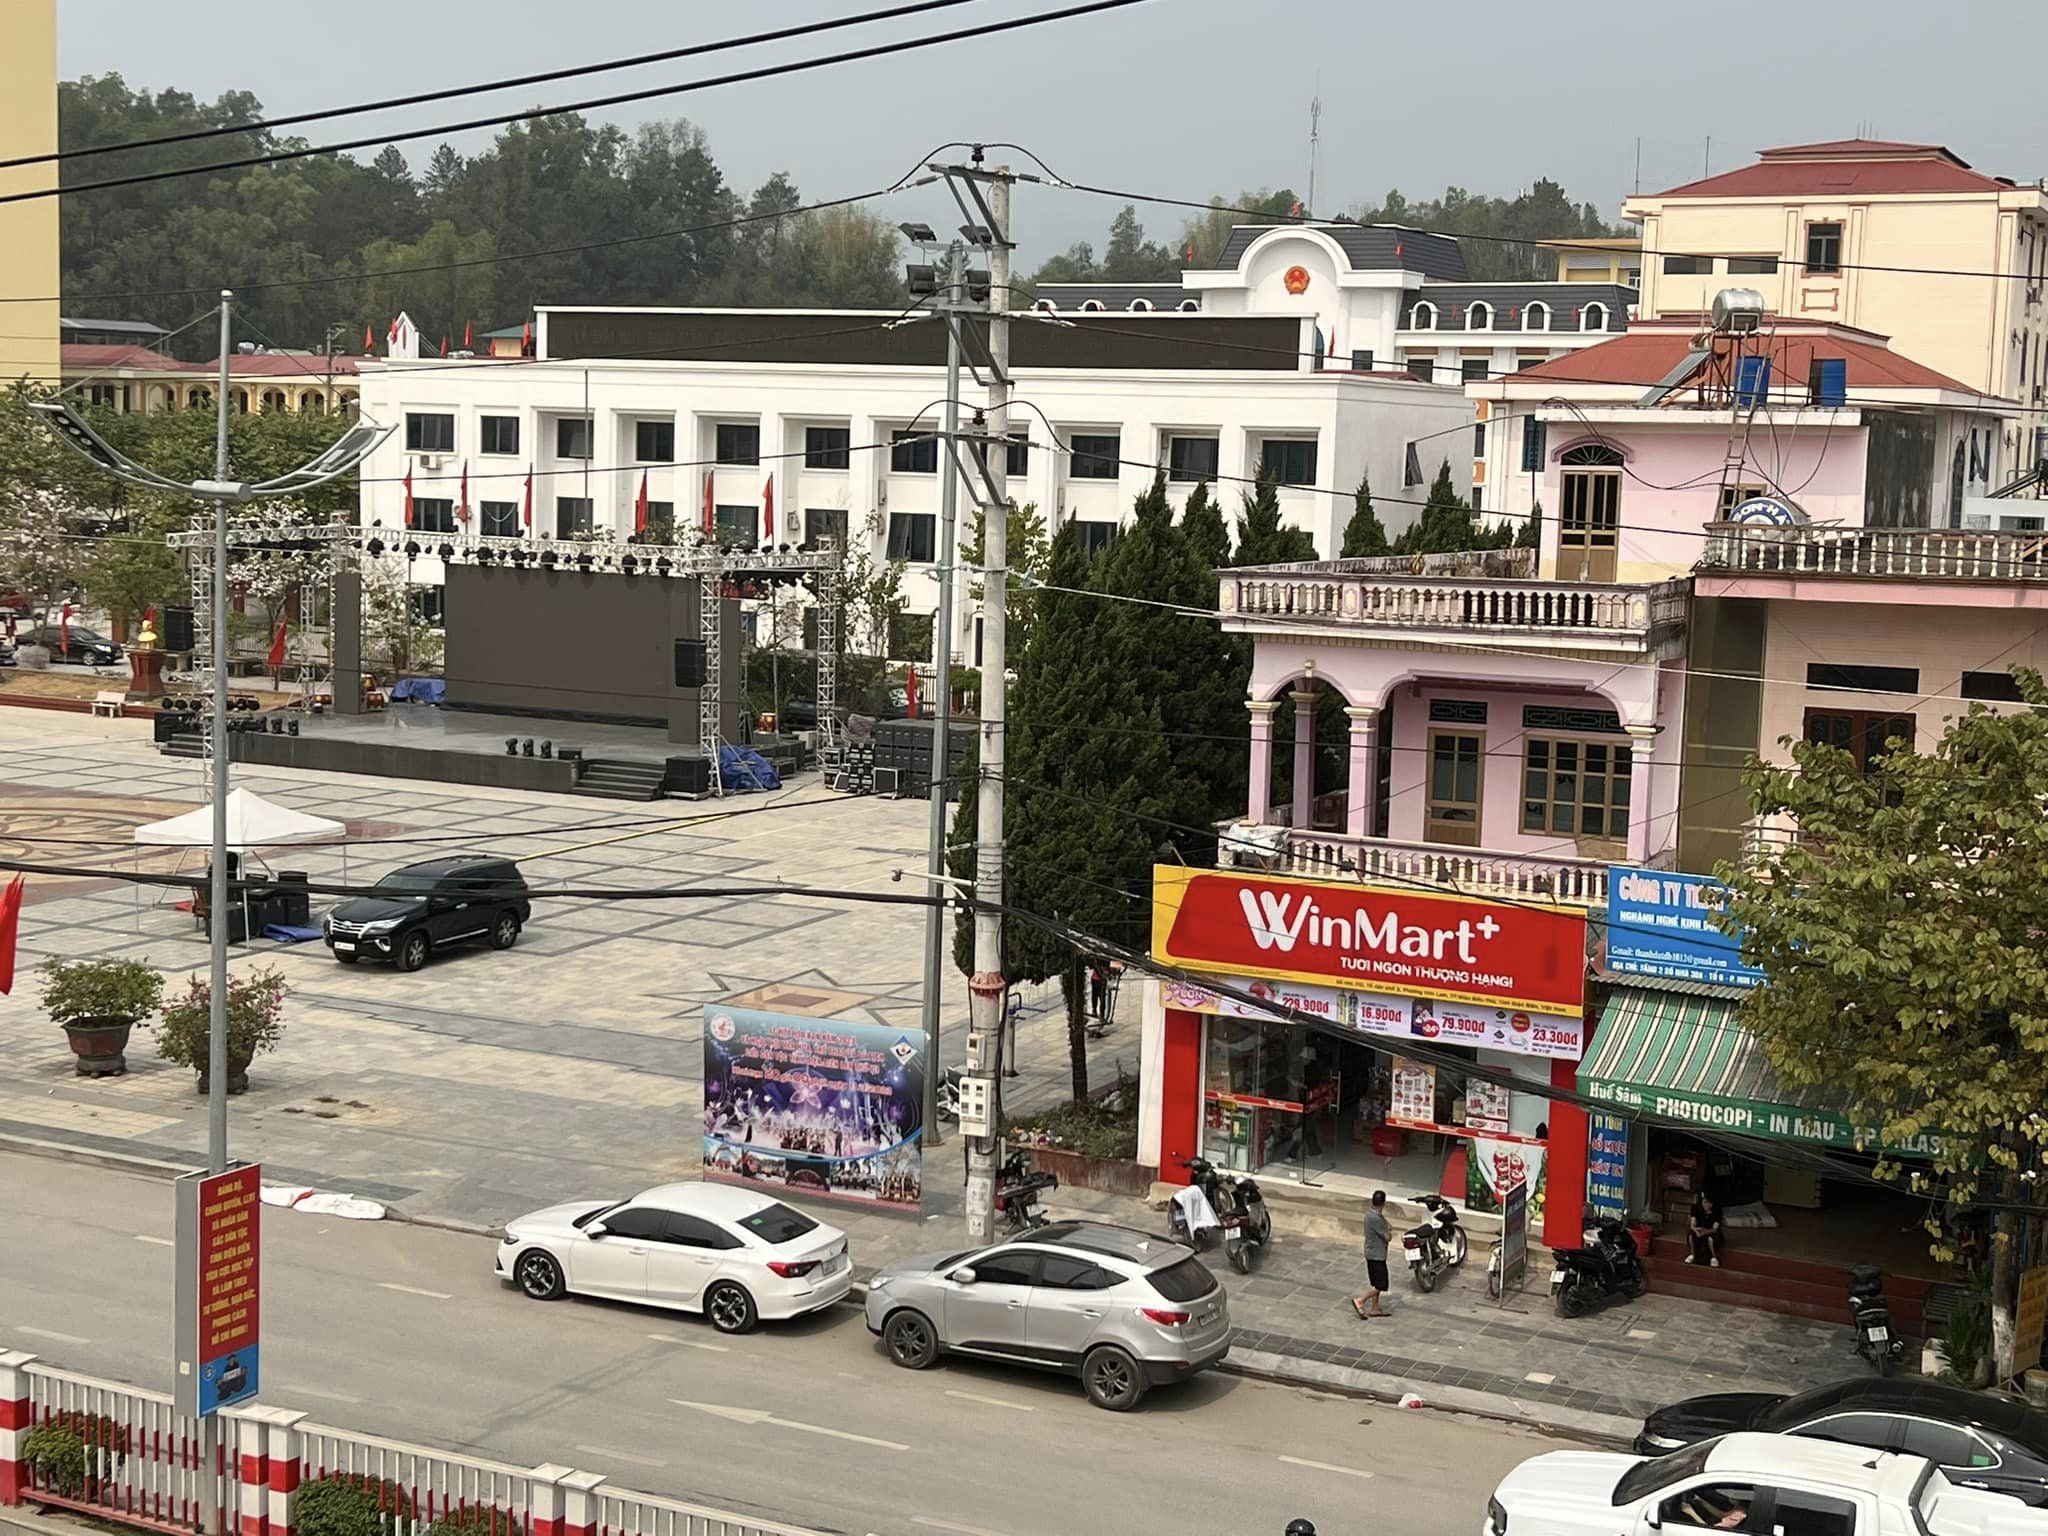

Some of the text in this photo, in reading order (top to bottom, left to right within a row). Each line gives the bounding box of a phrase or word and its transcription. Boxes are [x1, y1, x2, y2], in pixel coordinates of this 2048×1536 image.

[1619, 872, 1660, 904] CÔNG
[1663, 881, 1681, 906] TY
[1373, 961, 1411, 976] NGON
[1472, 973, 1513, 989] HẠNG!
[1656, 1097, 1753, 1129] PHOTOCOPI
[1770, 1114, 1789, 1135] IN
